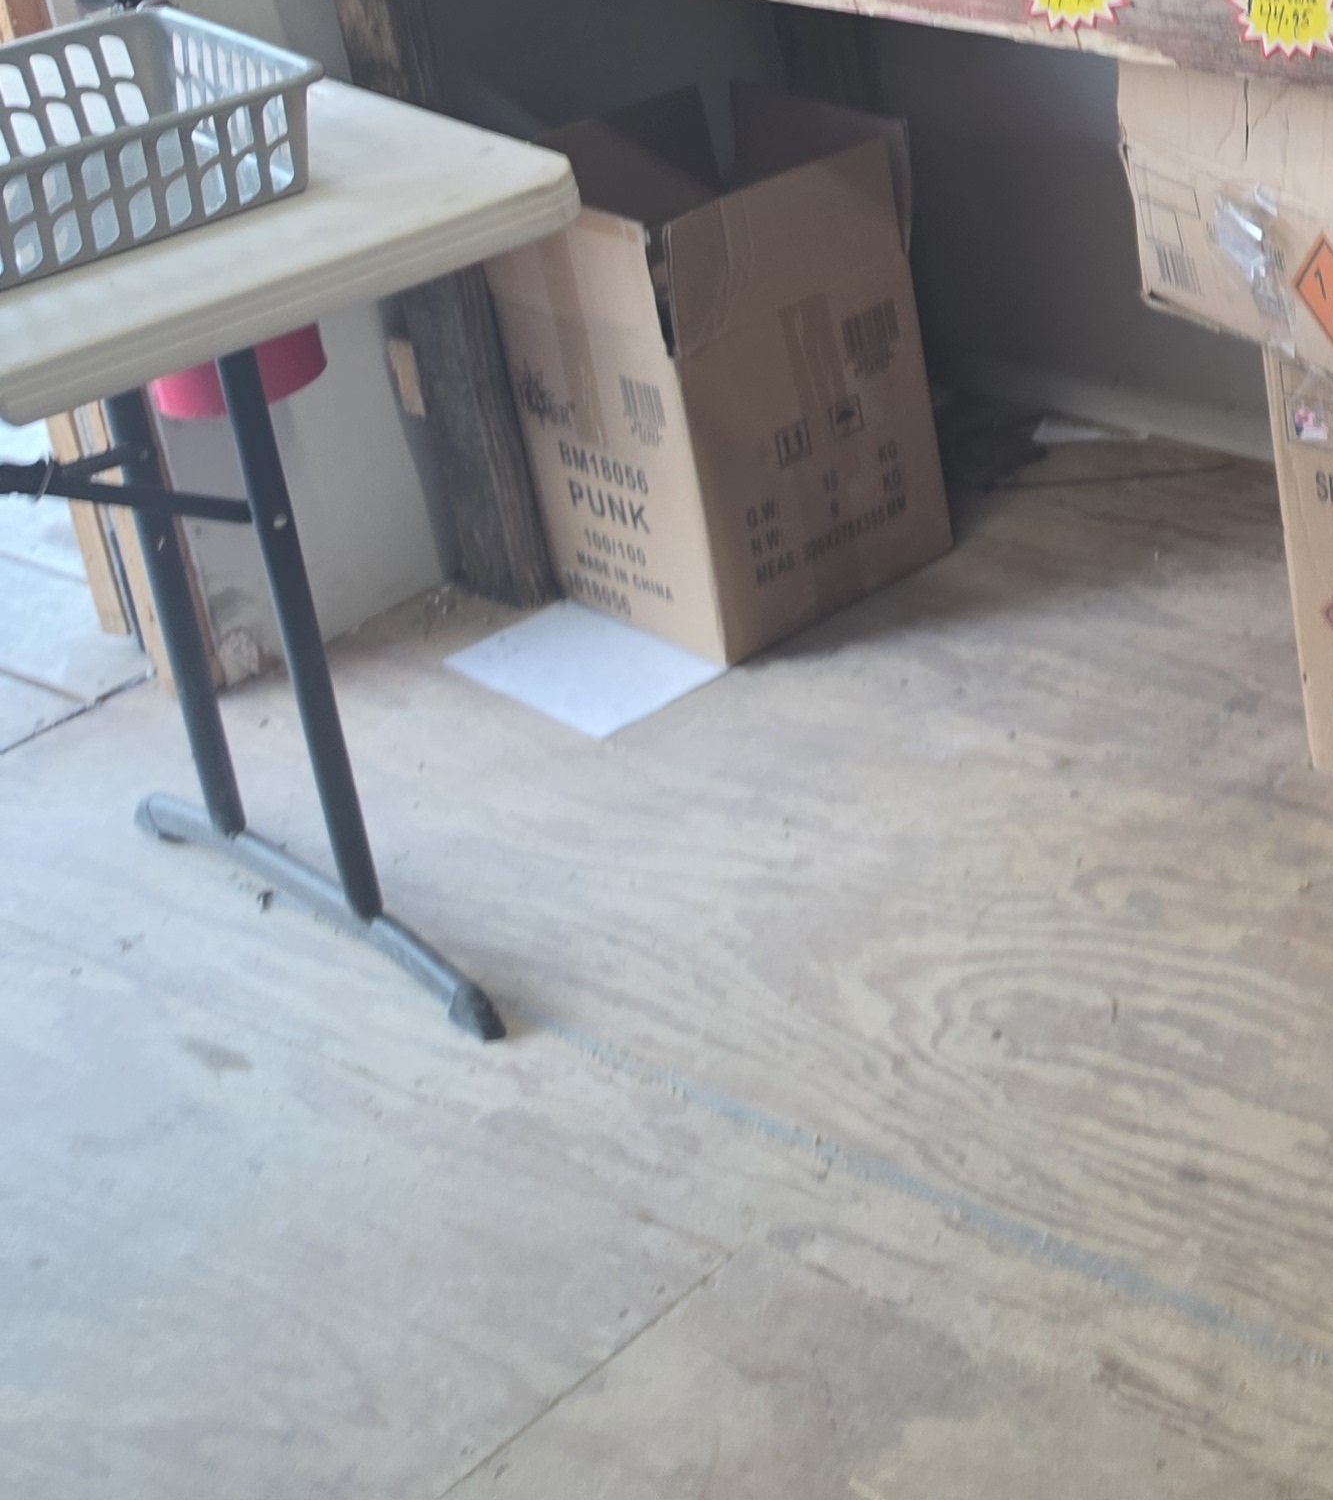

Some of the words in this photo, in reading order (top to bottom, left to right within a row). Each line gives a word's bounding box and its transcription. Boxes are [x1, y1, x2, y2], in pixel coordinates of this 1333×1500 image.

[558, 438, 650, 496] BM18056
[568, 478, 652, 536] PUNK
[576, 549, 610, 579] MADE
[613, 563, 629, 587] IN
[632, 573, 675, 605] CHINA
